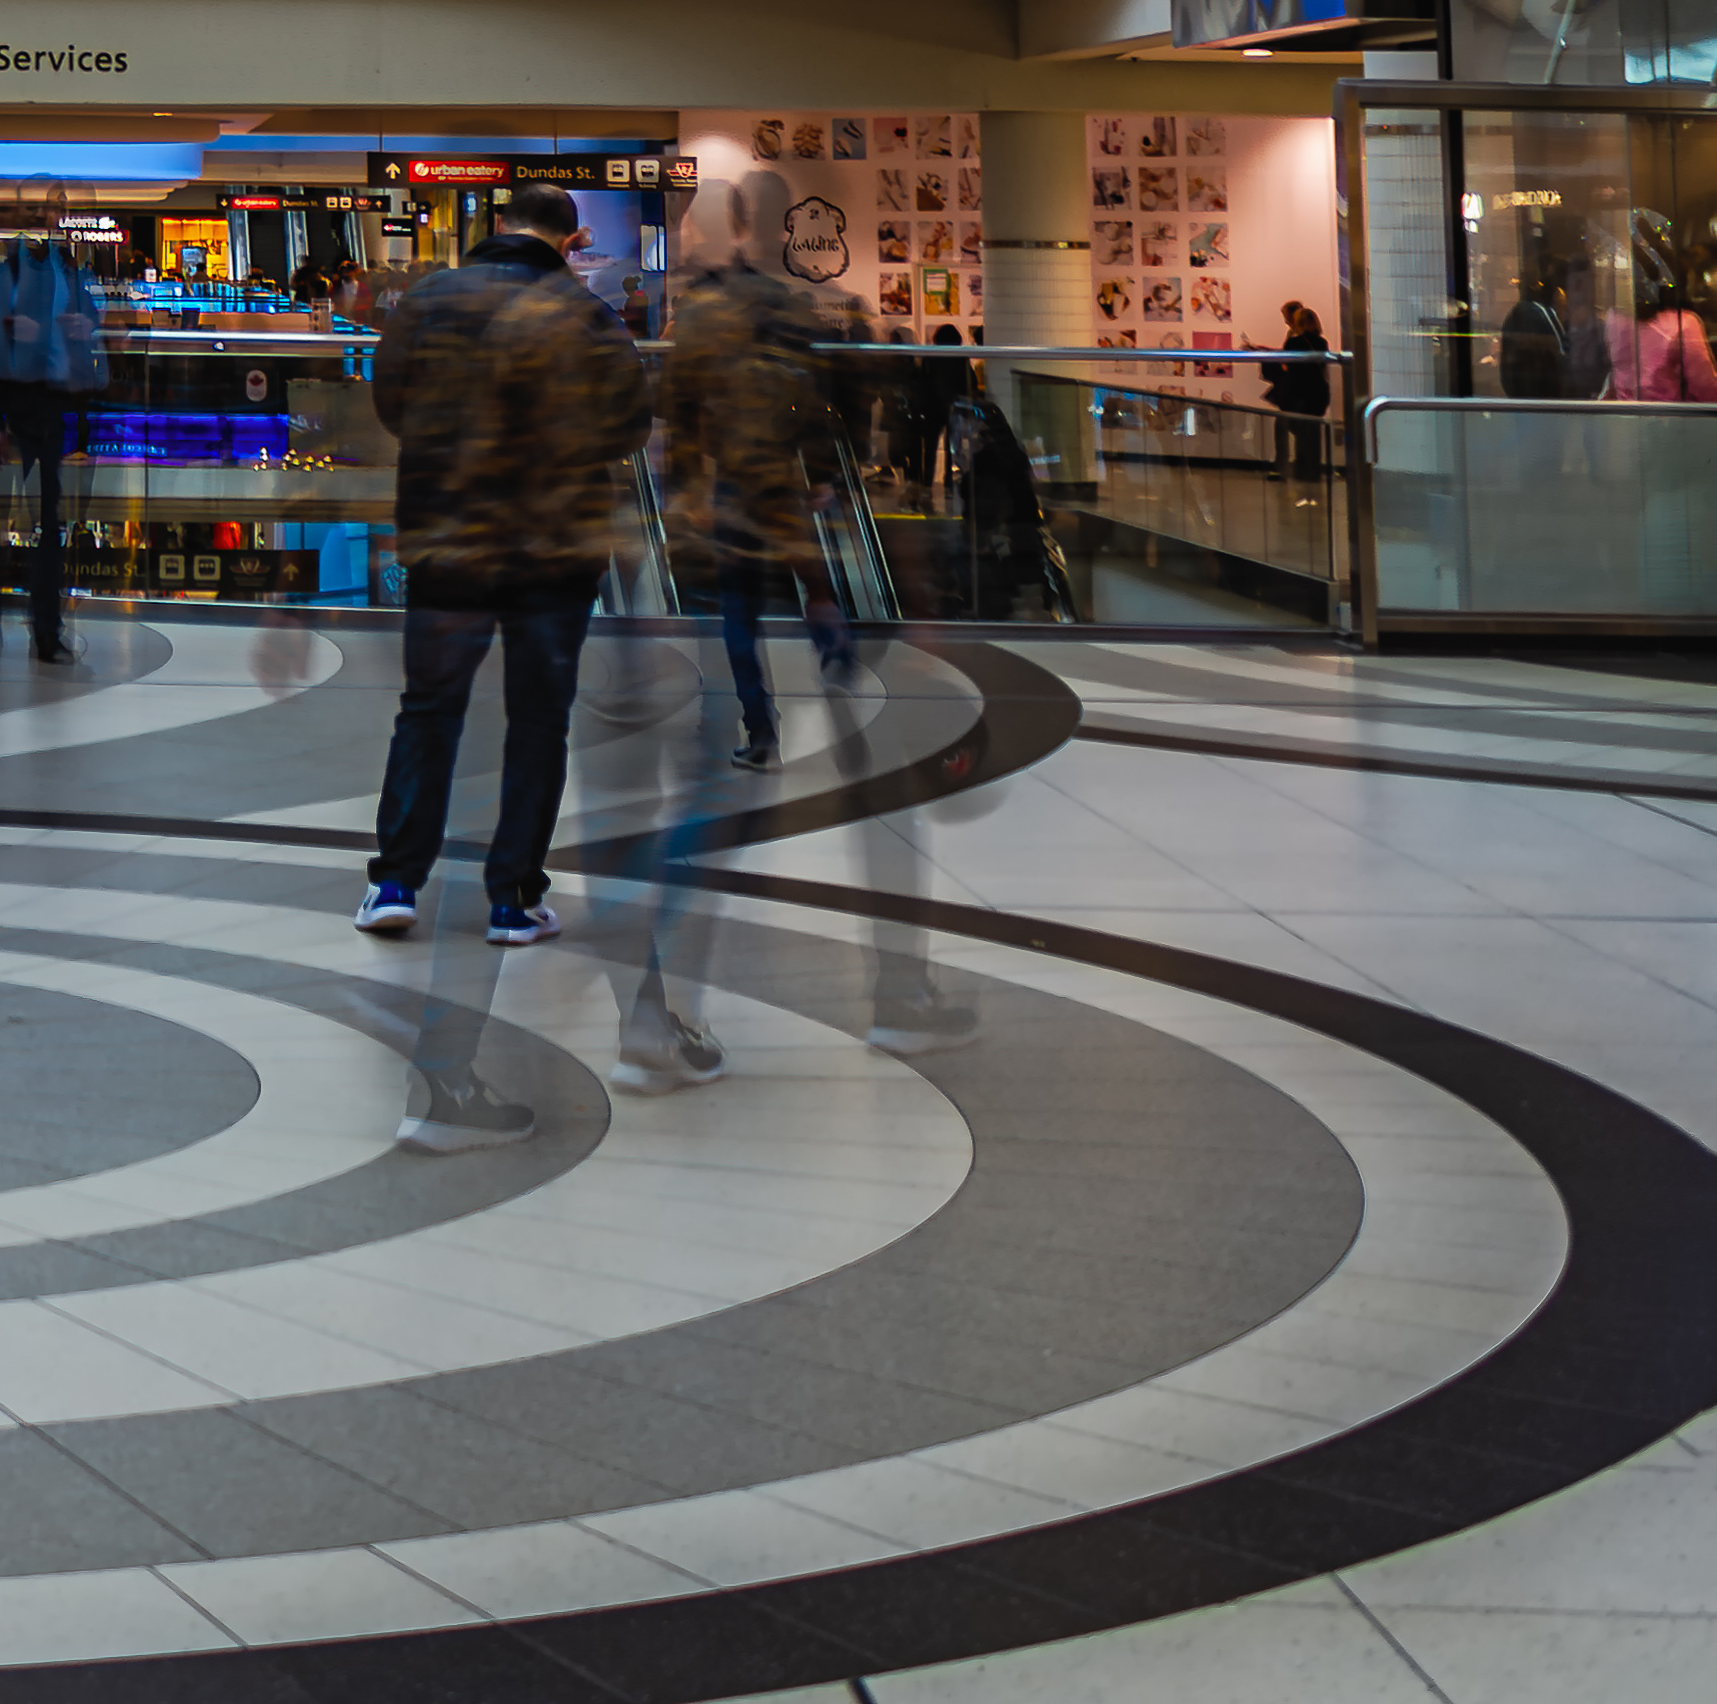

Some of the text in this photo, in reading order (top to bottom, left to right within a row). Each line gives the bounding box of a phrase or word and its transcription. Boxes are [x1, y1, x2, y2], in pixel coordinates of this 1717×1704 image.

[430, 164, 466, 177] urban
[466, 165, 504, 179] eatery
[516, 165, 573, 179] Dundas
[576, 165, 596, 180] St.
